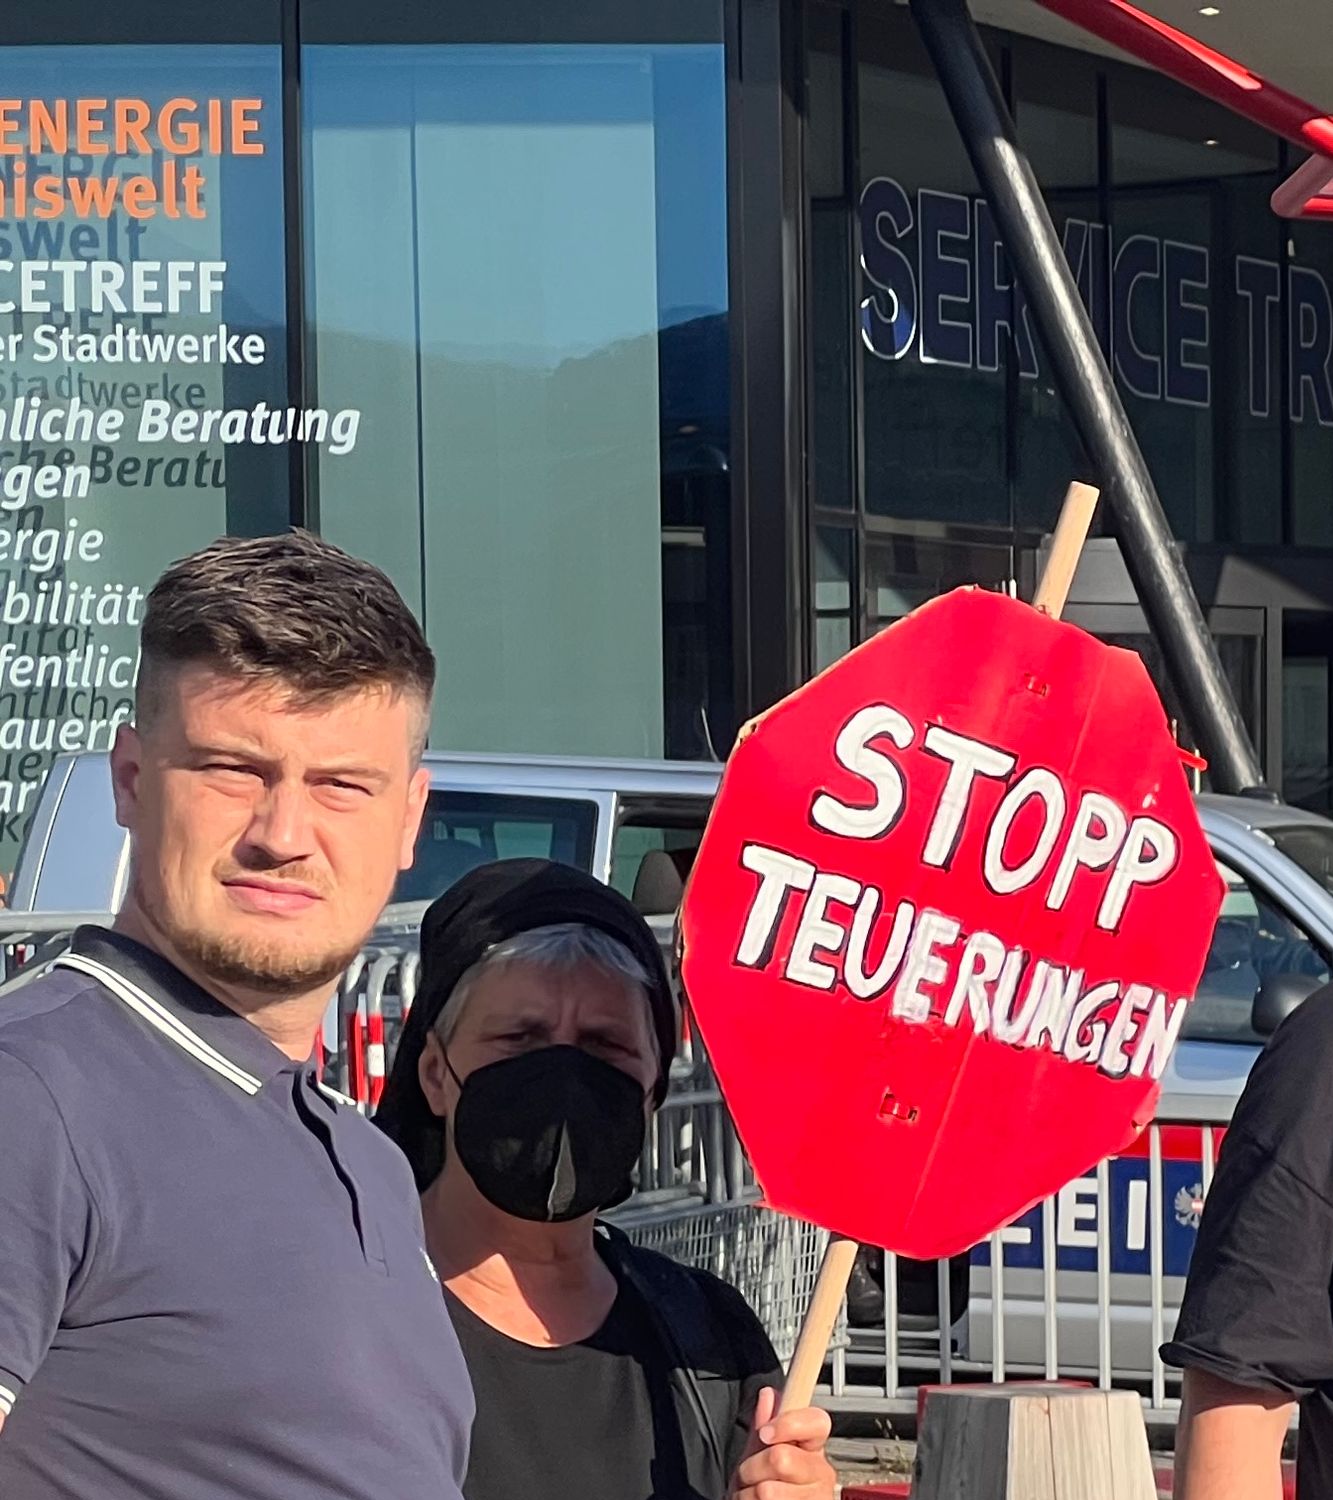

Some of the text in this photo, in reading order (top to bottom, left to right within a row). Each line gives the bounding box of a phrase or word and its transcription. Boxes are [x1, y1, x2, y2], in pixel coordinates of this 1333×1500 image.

[0, 98, 264, 155] ENERGIE
[0, 160, 206, 219] iswelt
[33, 324, 266, 365] Stadtwerke
[138, 399, 361, 455] Beratung
[810, 703, 1178, 934] STOPP
[734, 844, 1188, 1080] TEUERUNGEN
